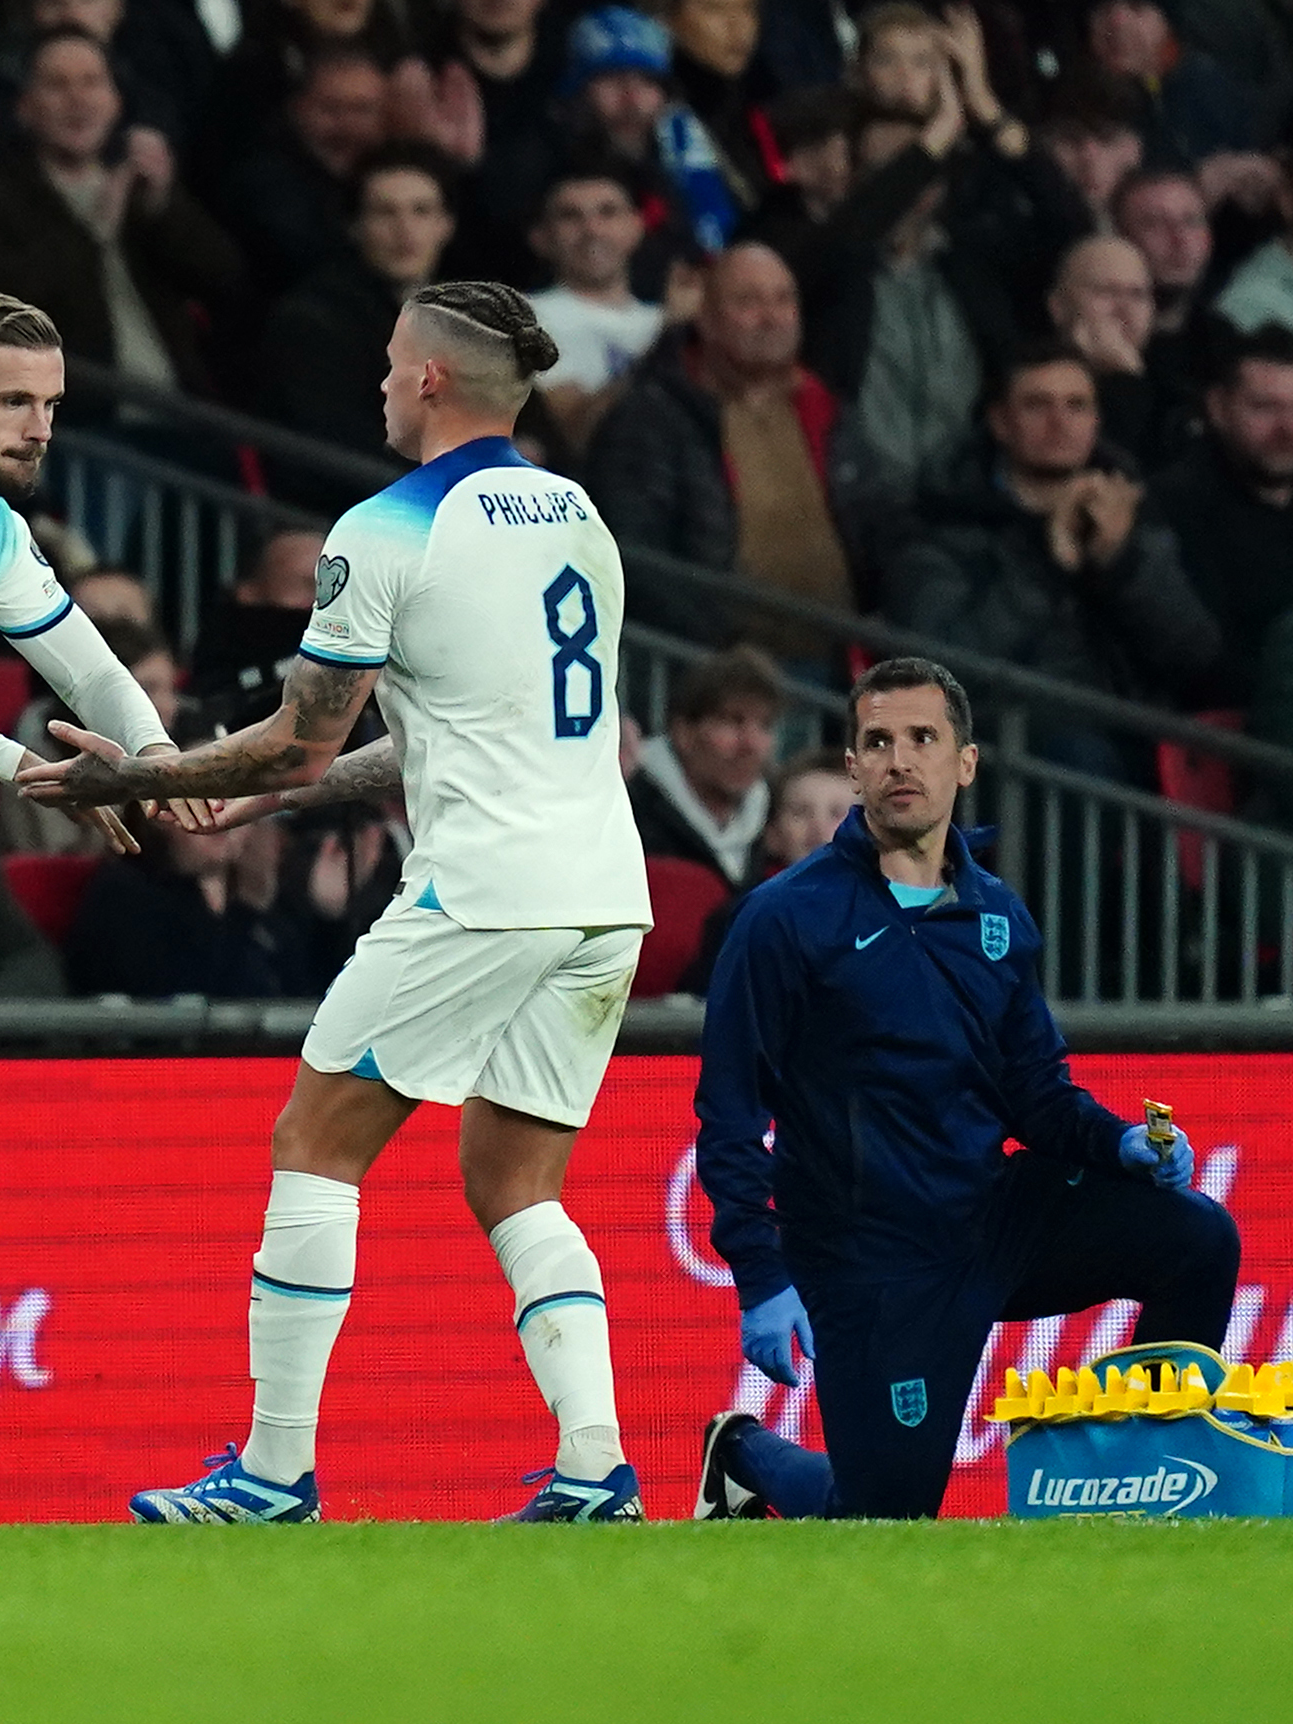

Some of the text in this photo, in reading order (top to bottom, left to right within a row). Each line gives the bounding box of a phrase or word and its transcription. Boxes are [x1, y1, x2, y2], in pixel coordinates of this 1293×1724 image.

[478, 491, 588, 525] PHILLIPS
[543, 562, 603, 740] 8
[1026, 1465, 1189, 1507] Lucozade
